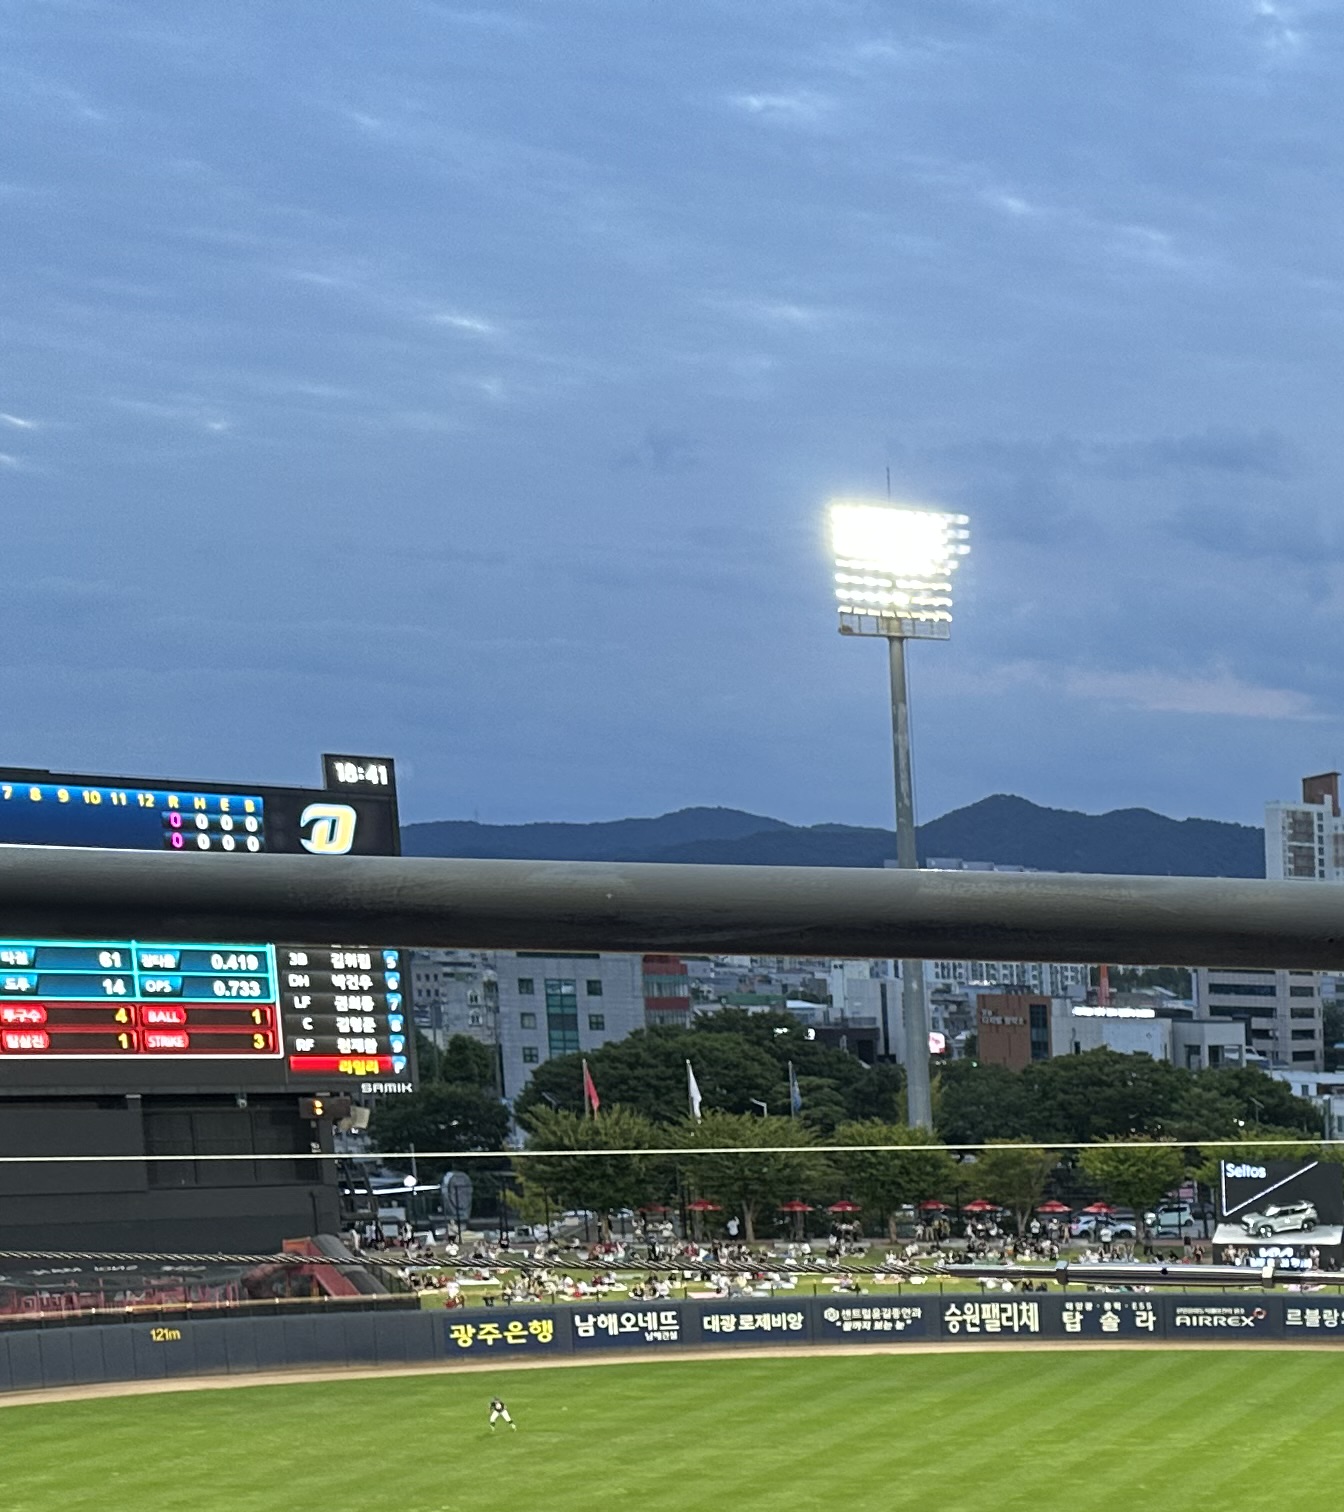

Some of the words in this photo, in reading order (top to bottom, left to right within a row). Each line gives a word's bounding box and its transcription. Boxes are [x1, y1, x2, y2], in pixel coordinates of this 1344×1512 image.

[334, 761, 388, 785] 18:41
[2, 785, 13, 800] 7
[30, 787, 41, 801] 8
[57, 788, 69, 803] 9
[82, 790, 101, 804] 10
[110, 792, 127, 806] 11
[138, 793, 155, 808] 12
[168, 795, 179, 809] R
[193, 797, 206, 810] H
[220, 798, 230, 812] E
[245, 799, 255, 813] B
[170, 812, 181, 828] 0
[195, 814, 209, 830] 0
[220, 815, 234, 831] 0
[245, 816, 258, 832] 0
[171, 833, 183, 849] 0
[197, 834, 211, 850] 0
[222, 834, 235, 851] 0
[247, 835, 260, 852] 0
[99, 951, 122, 968] 61
[102, 978, 127, 995] 14
[145, 979, 172, 993] OPS
[213, 980, 261, 997] 0.733
[288, 973, 310, 988] DH
[293, 995, 311, 1009] LF
[115, 1007, 128, 1023] 4
[148, 1010, 181, 1023] BALL
[251, 1008, 262, 1025] 1
[302, 1017, 314, 1031] C
[118, 1033, 128, 1049] 1
[148, 1035, 185, 1048] STRIKE
[253, 1033, 265, 1049] 3
[361, 1082, 413, 1094] SAMIK
[575, 1311, 680, 1337] 남해오네뜨
[703, 1314, 737, 1333] 대광
[738, 1312, 804, 1332] 로제비앙
[944, 1302, 1040, 1333] 승원팰리체
[1175, 1316, 1255, 1327] AIRREX
[150, 1328, 181, 1342] 121m
[450, 1319, 554, 1347] 광주은행
